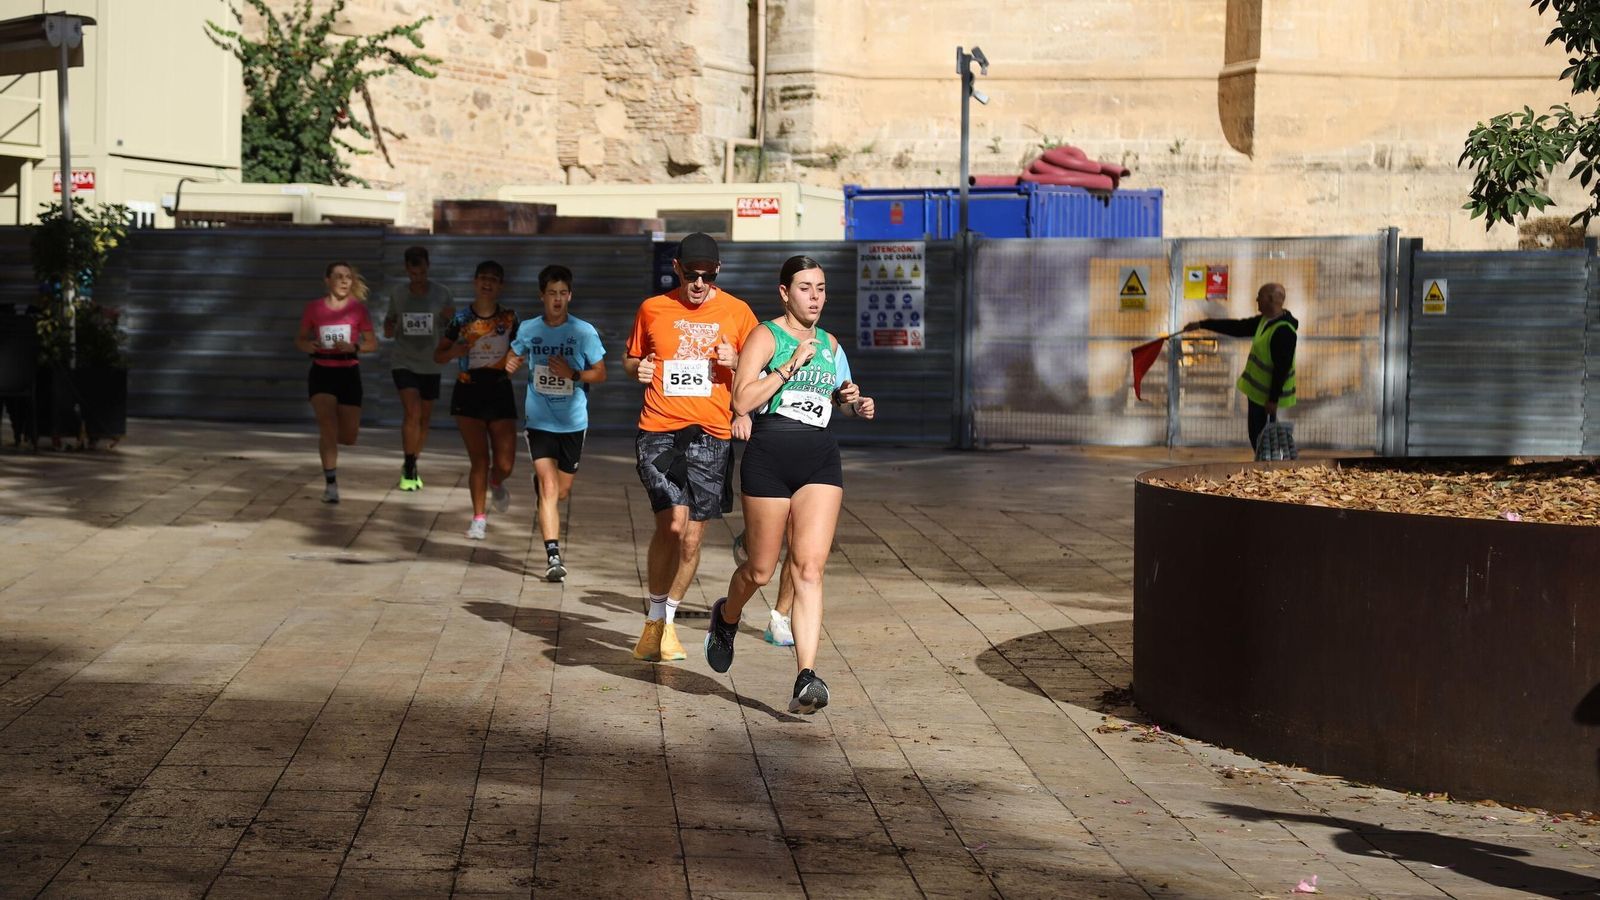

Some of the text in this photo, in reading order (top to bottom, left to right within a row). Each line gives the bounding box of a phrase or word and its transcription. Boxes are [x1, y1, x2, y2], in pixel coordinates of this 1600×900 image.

[54, 172, 95, 184] RMSA
[737, 198, 779, 210] REMSA
[406, 320, 428, 329] 841
[539, 375, 566, 386] 925
[670, 373, 704, 386] 526
